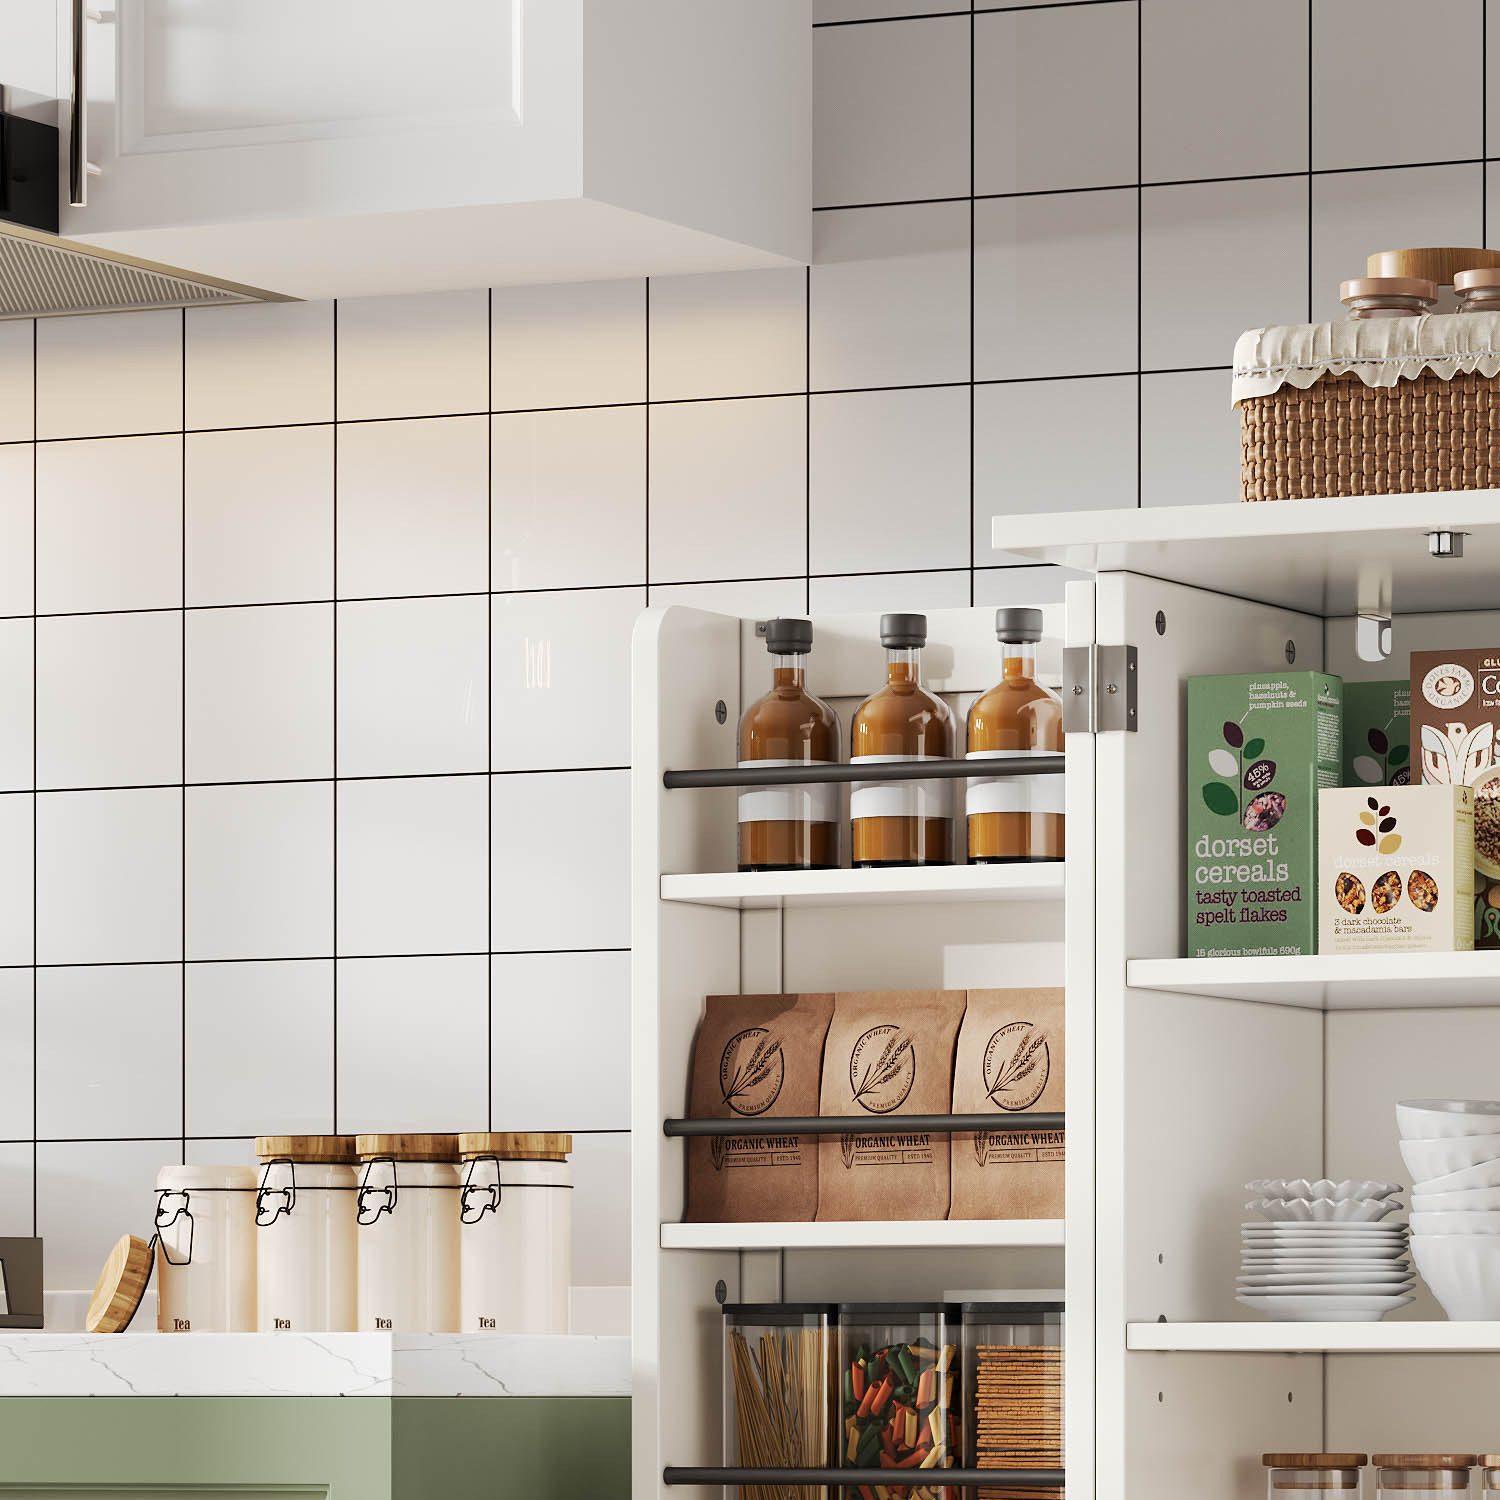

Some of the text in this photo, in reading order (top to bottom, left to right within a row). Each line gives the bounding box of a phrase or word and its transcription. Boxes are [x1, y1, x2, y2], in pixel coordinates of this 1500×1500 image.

[1195, 833, 1279, 858] dorset
[1195, 859, 1289, 884] cereals
[1196, 886, 1302, 907] tasty toasted
[1196, 907, 1287, 927] spelt flakes
[1334, 917, 1402, 926] 3 dark chocolate
[1334, 925, 1413, 935] & macadamia bars
[725, 1136, 799, 1151] ORGANIC WHEAT
[855, 1134, 930, 1149] ORGANIC WHEAT
[989, 1132, 1065, 1147] ORGANIC WHEAT
[173, 1318, 191, 1330] Tea
[274, 1318, 291, 1330] Tea
[375, 1318, 392, 1330] Tea
[478, 1317, 496, 1328] Tea
